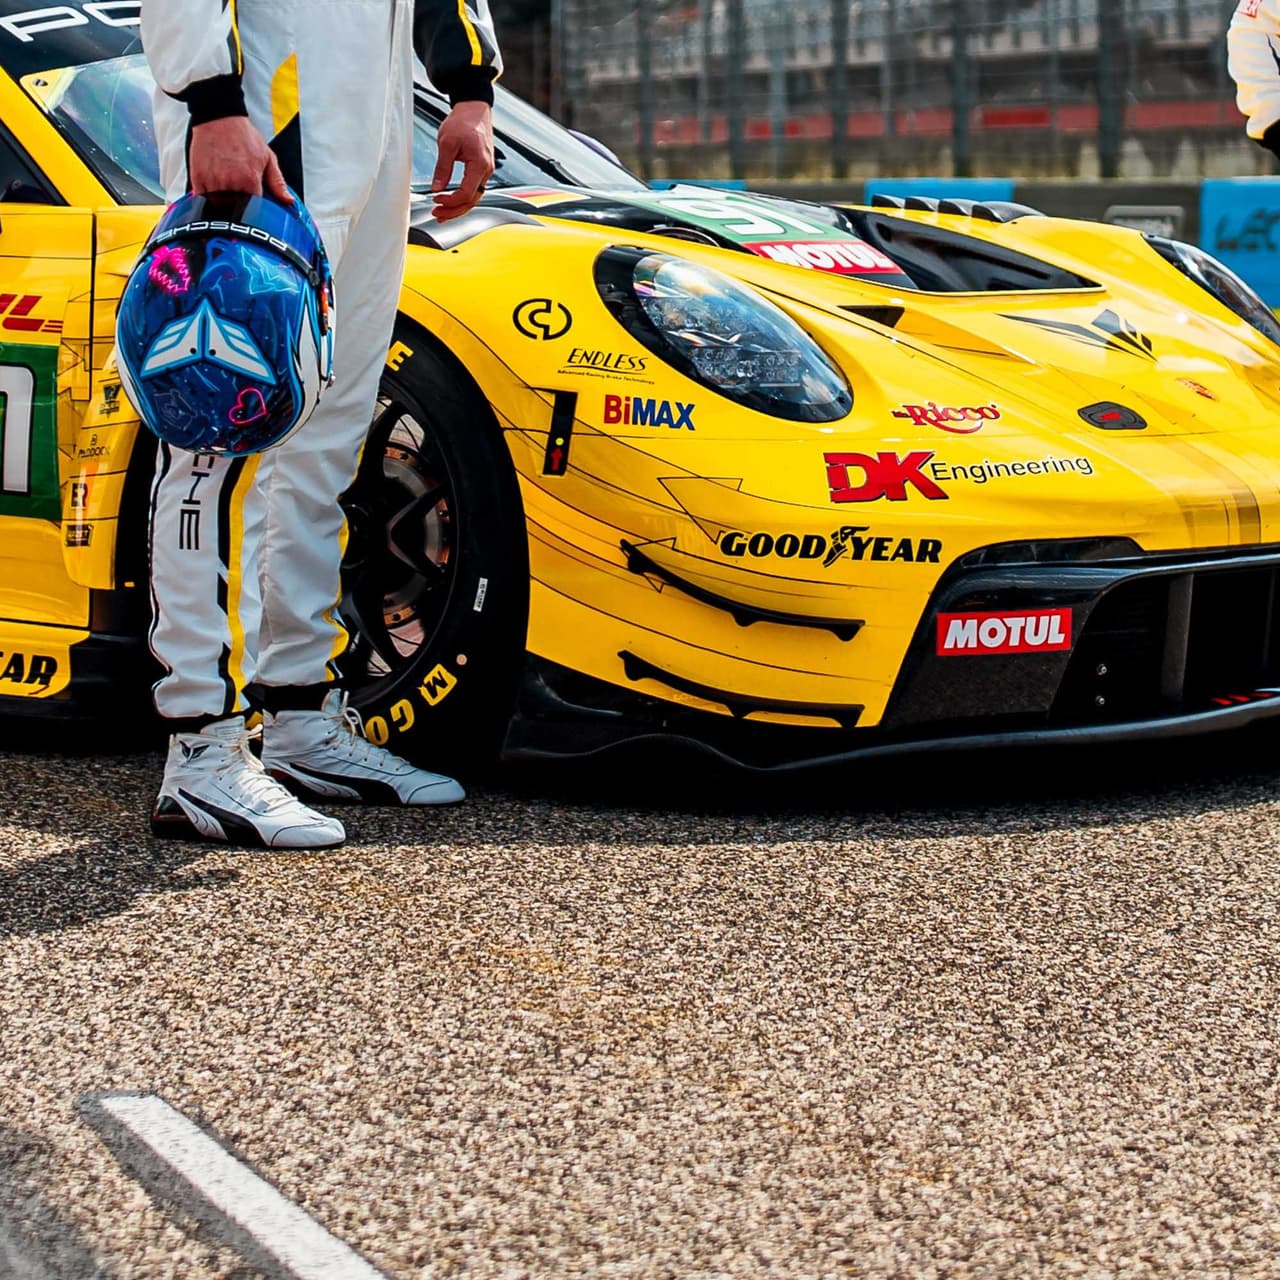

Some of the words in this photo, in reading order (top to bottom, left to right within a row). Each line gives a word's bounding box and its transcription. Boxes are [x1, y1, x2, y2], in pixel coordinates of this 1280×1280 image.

[661, 197, 825, 236] 91
[156, 221, 287, 252] PORSCHE
[759, 243, 894, 269] MOTUL
[557, 369, 585, 377] Advanced
[567, 348, 649, 371] ENDLESS
[603, 394, 696, 431] BiMAX
[823, 451, 949, 503] DK
[932, 456, 1094, 484] Engineering
[719, 525, 943, 568] GOODYEAR
[943, 614, 1065, 650] MOTUL
